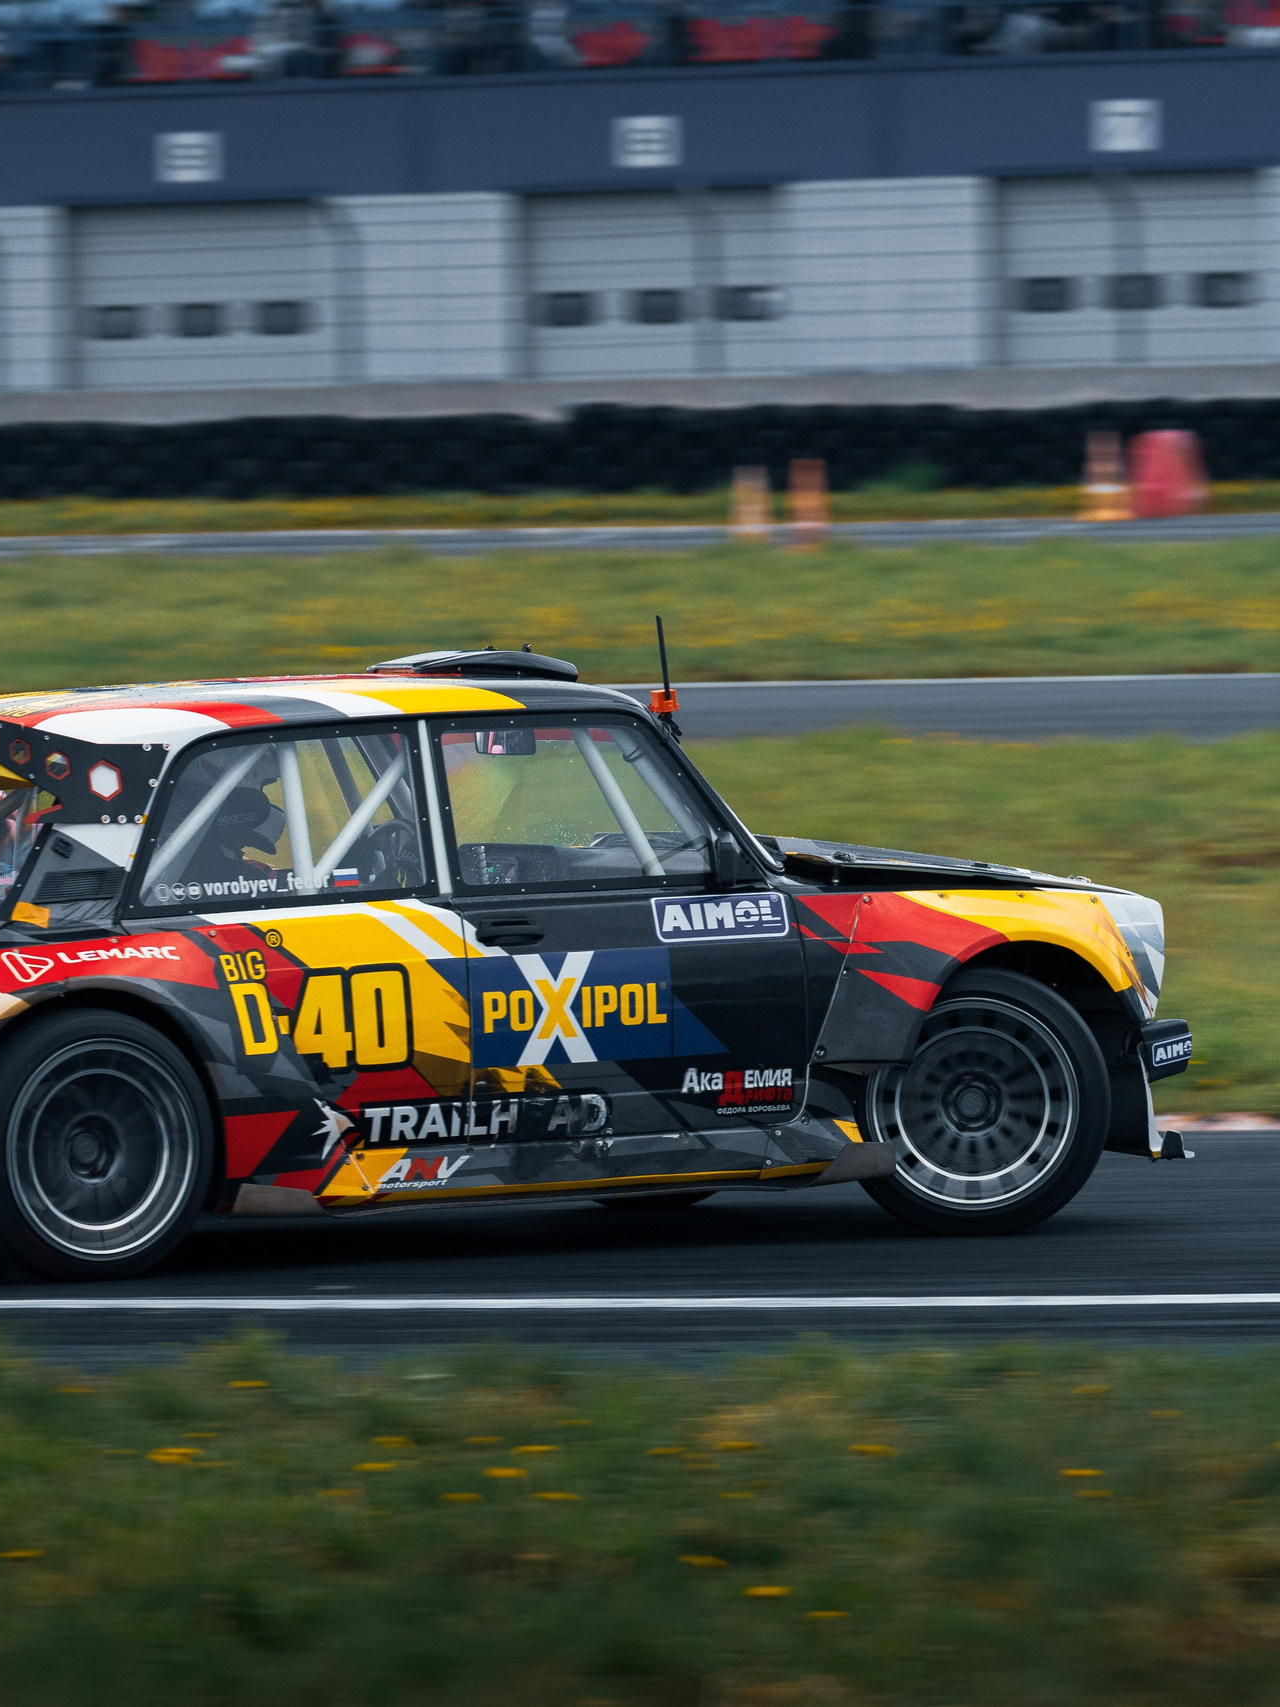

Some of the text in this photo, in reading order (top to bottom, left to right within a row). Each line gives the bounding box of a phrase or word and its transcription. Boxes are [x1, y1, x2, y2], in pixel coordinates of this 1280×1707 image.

[662, 900, 782, 931] AIMOL
[57, 946, 181, 963] LEMARC
[219, 951, 266, 981] BIG
[229, 971, 408, 1068] D-40
[483, 951, 668, 1066] POXIPOL
[1155, 1040, 1192, 1062] AIMO
[364, 1093, 607, 1142] TRAILHAD
[717, 1104, 791, 1115] ФЕДОРА ВОРОБЬЕВА
[377, 1155, 470, 1182] ANV
[375, 1178, 447, 1190] motorsport
